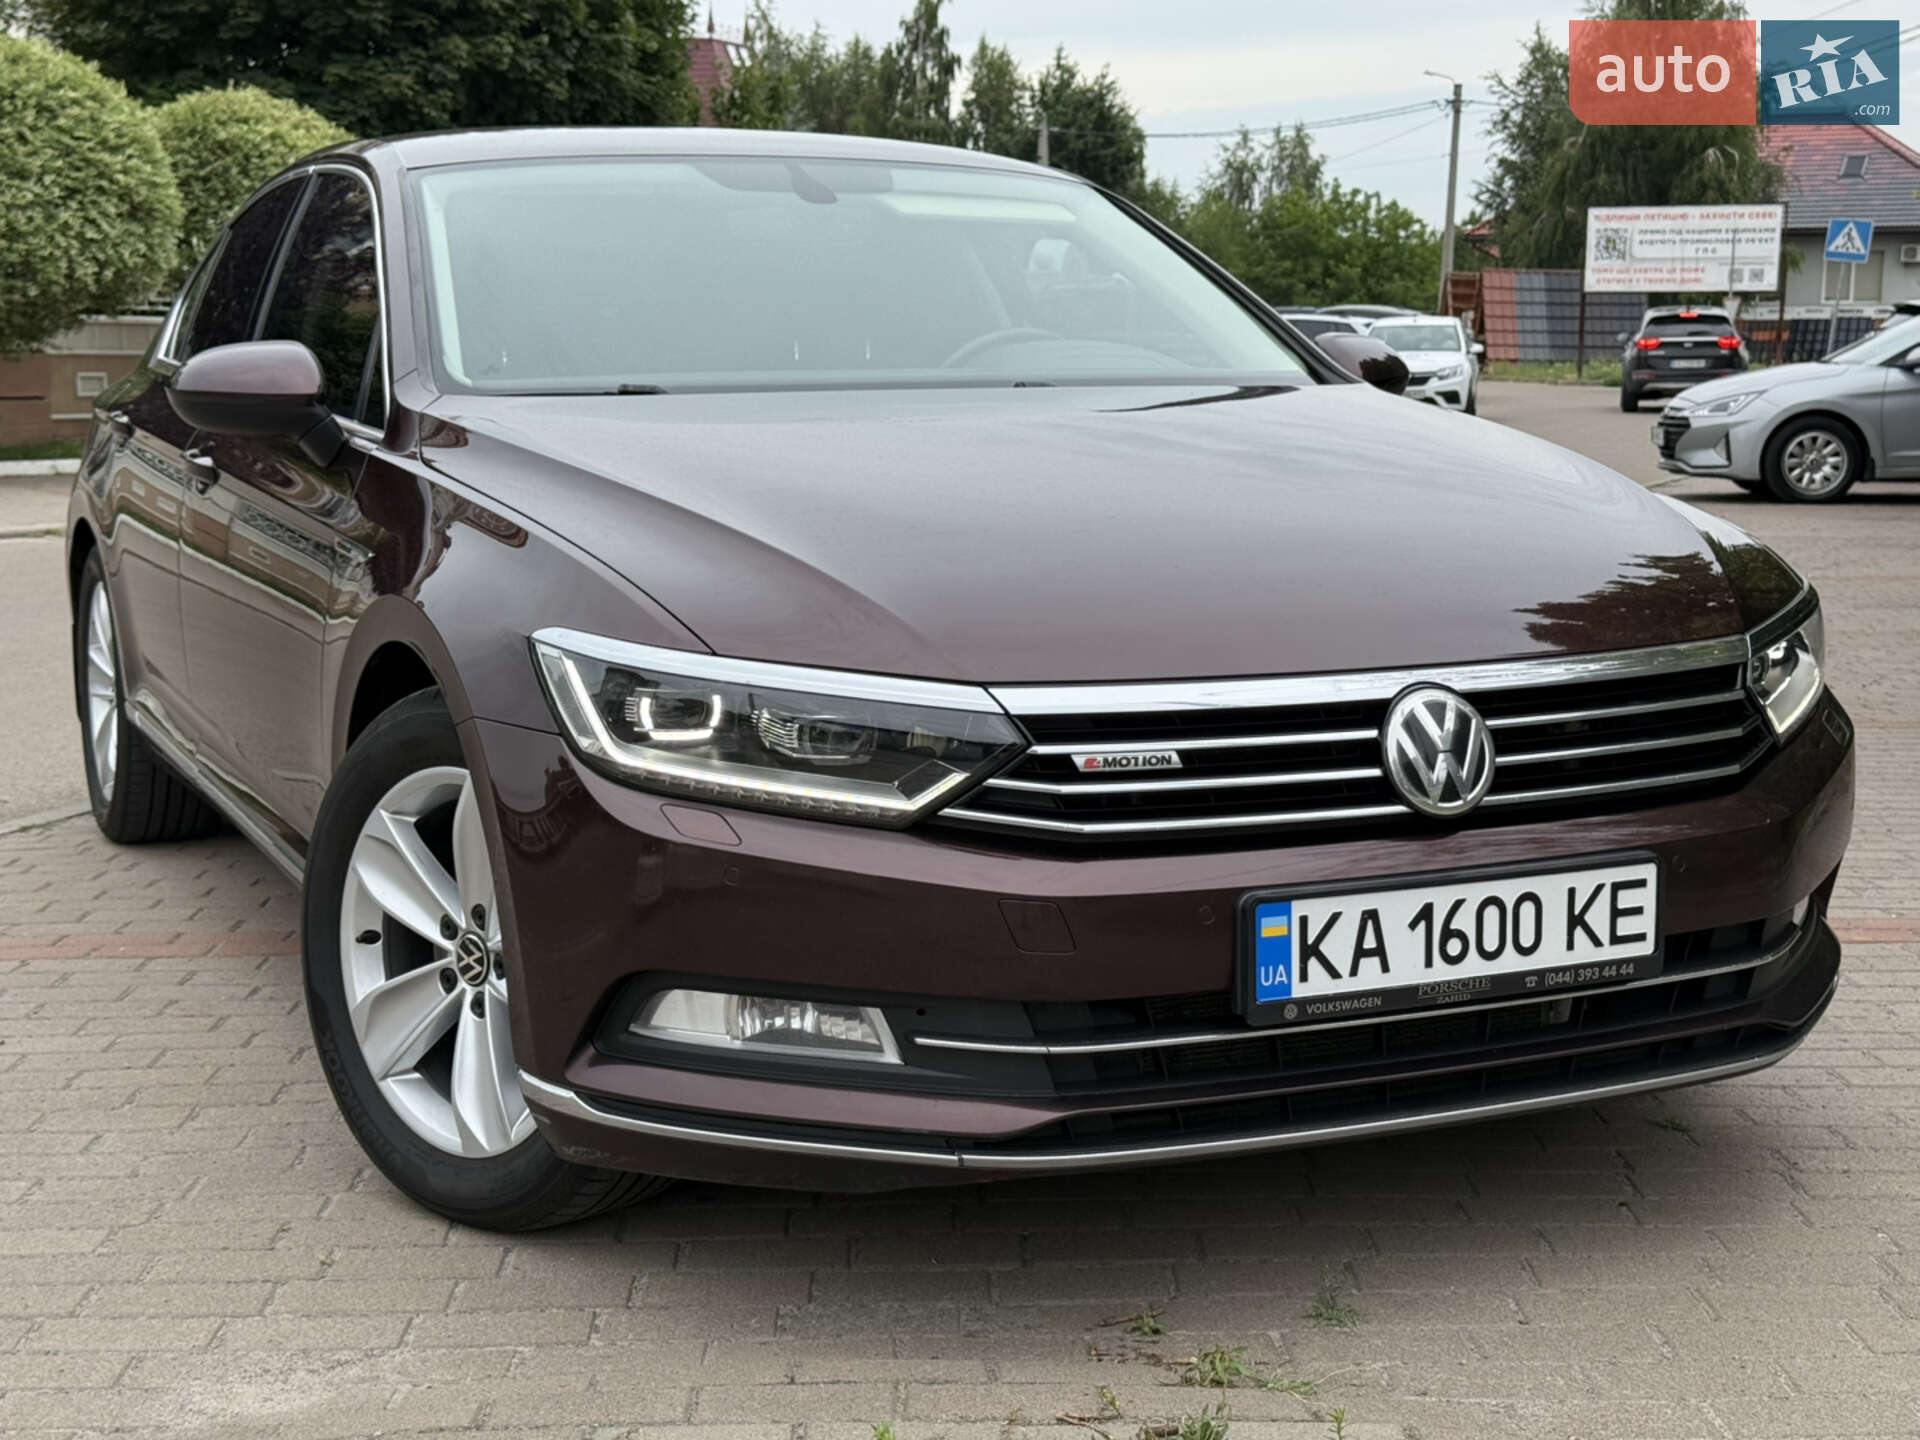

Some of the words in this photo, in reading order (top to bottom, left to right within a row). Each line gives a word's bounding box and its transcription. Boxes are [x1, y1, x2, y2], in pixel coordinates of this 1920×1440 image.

[1084, 754, 1172, 769] 4MOTION
[1299, 908, 1390, 983] KA
[1408, 890, 1543, 969] 1600
[1566, 878, 1647, 951] KE
[1260, 964, 1288, 986] UA
[1545, 968, 1574, 987] (044)
[1578, 967, 1599, 981] 393
[1602, 964, 1617, 978] 44
[1619, 962, 1635, 976] 44
[1418, 975, 1491, 996] PORSCHE
[1306, 996, 1382, 1015] VOLKSWAGEN
[1436, 992, 1471, 1004] ZAHID
